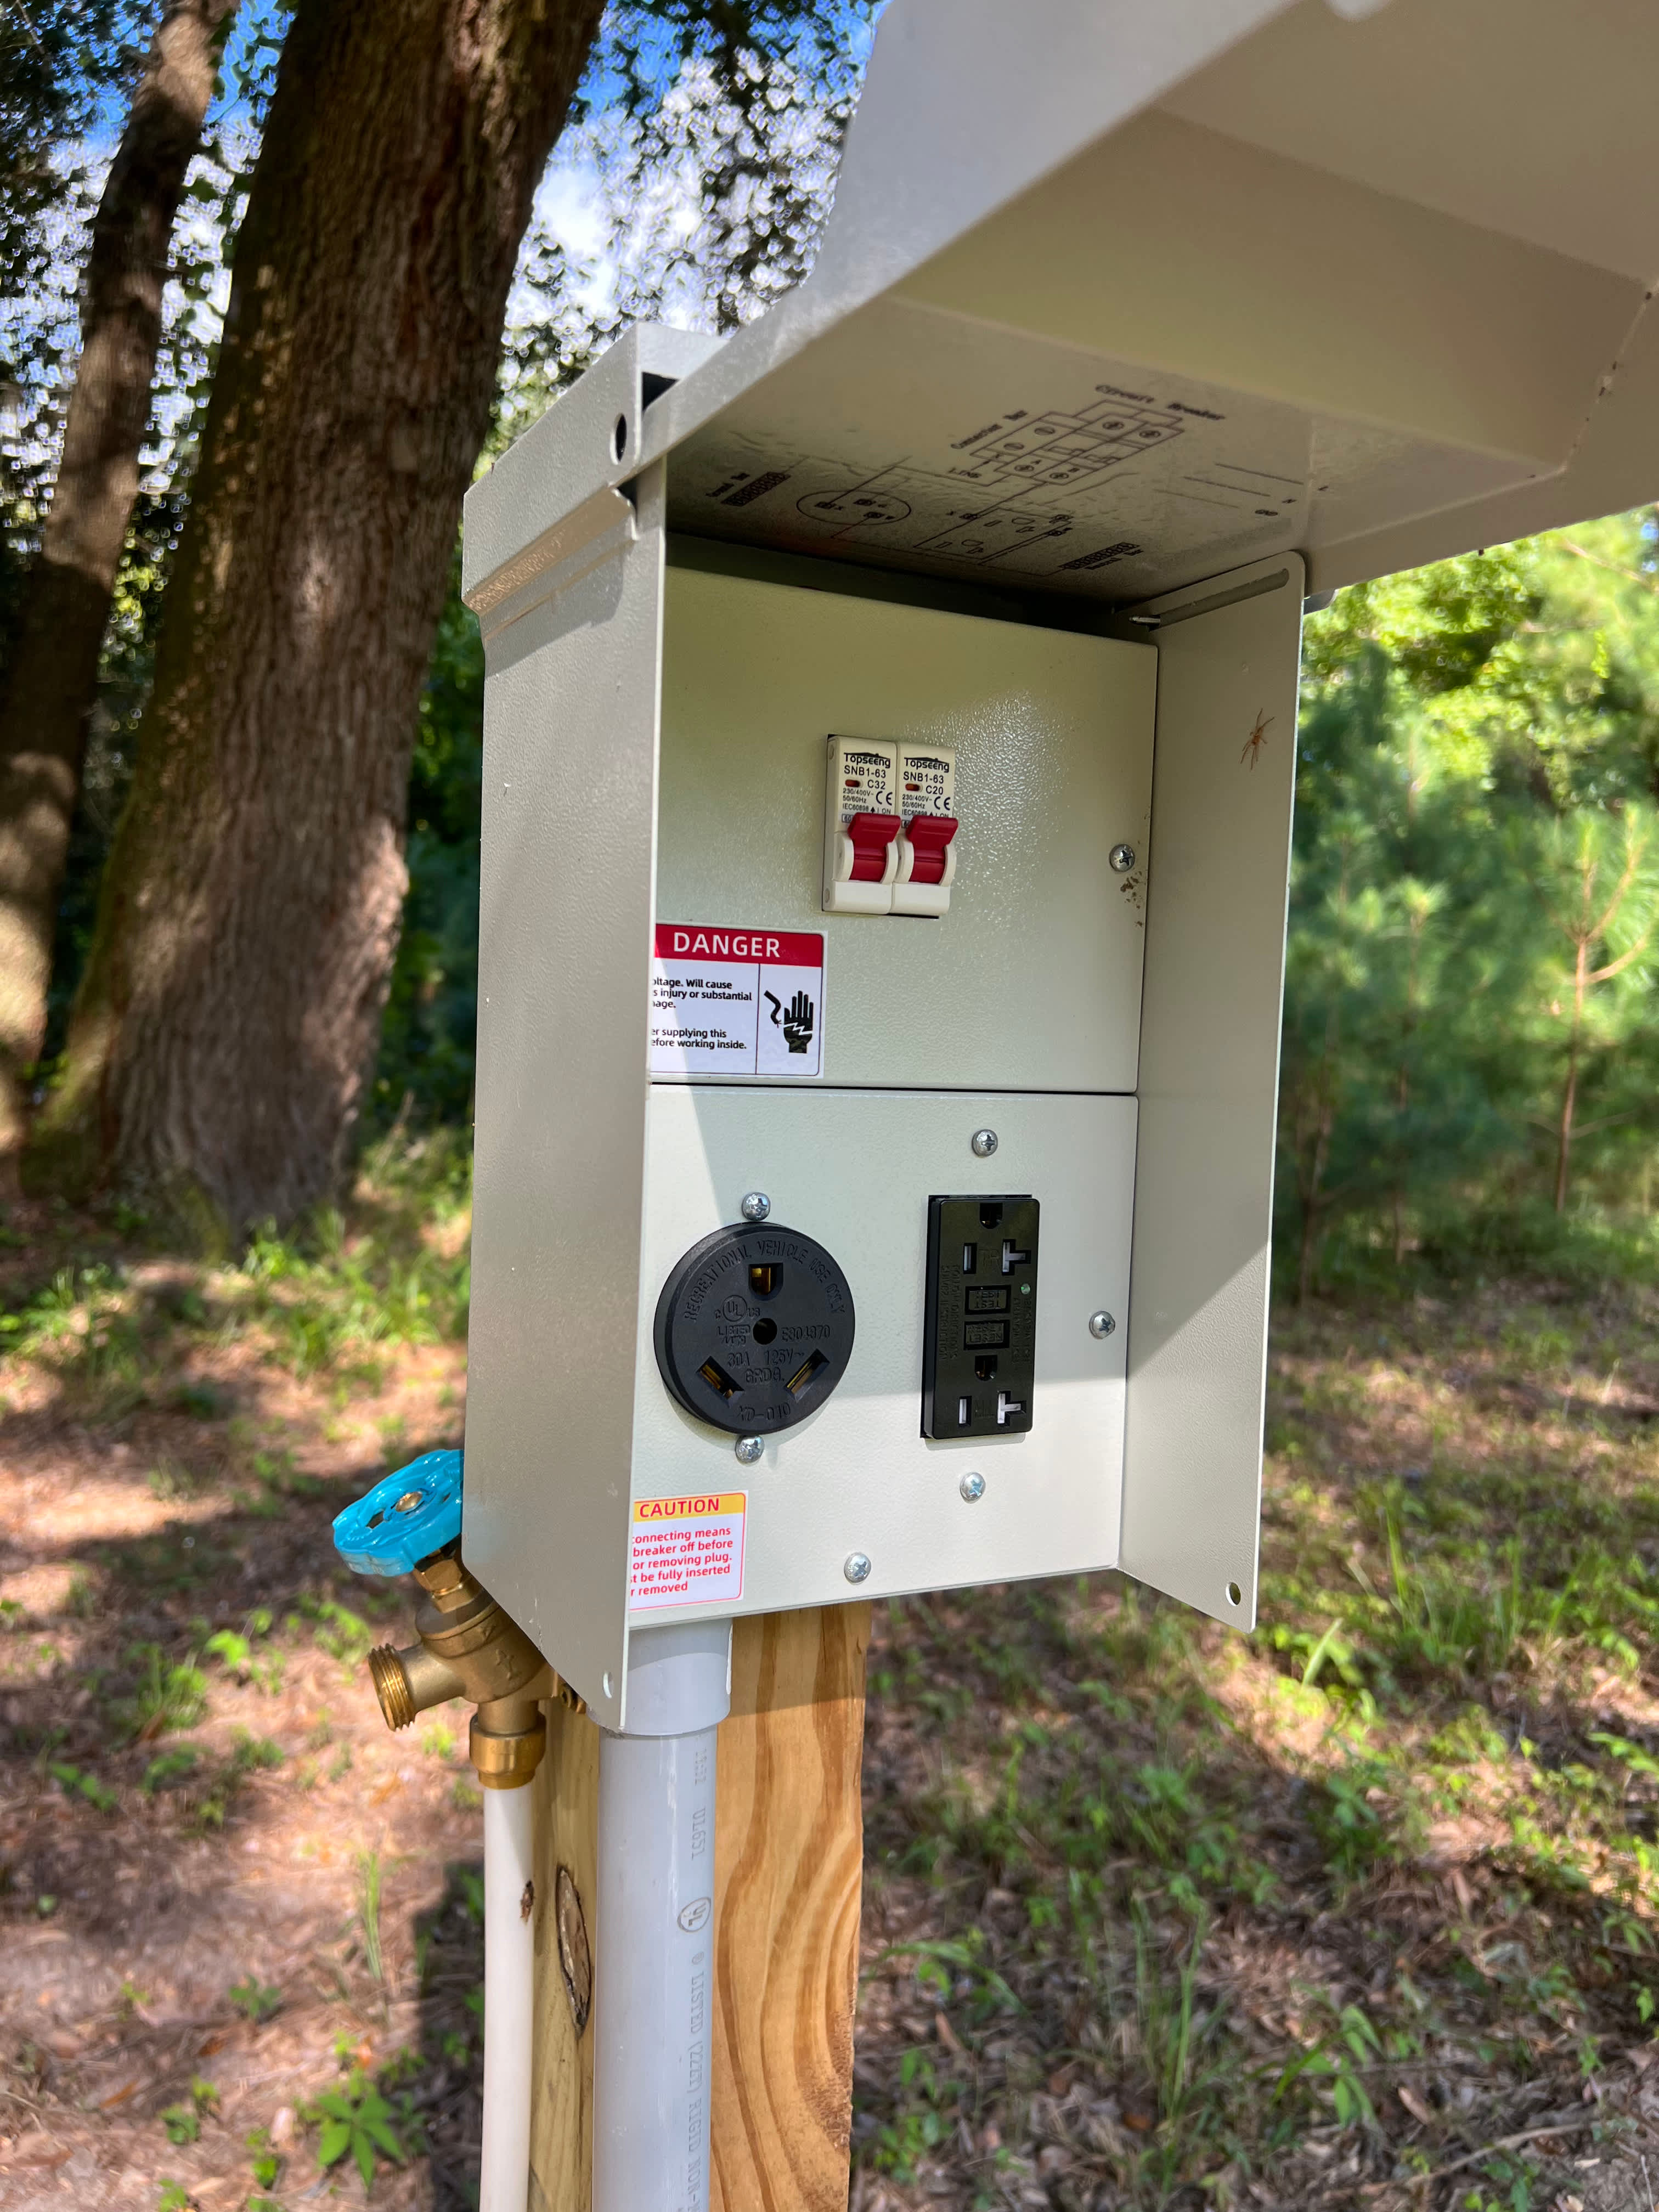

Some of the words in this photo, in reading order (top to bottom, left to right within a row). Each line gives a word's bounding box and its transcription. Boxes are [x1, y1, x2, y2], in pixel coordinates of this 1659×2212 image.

[844, 765, 886, 778] SNB1-63
[903, 771, 944, 784] SNB1-63
[867, 780, 886, 790] C32
[926, 785, 944, 795] C20
[842, 795, 867, 803] 50/60Hz
[842, 803, 869, 812] IEC60898
[674, 932, 780, 957] DANGER
[686, 979, 703, 988] Will
[706, 981, 732, 989] cause
[661, 988, 687, 999] injury
[701, 991, 752, 1001] substantial
[662, 1028, 708, 1039] supplying
[710, 1029, 726, 1037] this
[678, 1039, 715, 1049] working
[717, 1040, 747, 1049] inside.
[757, 1240, 808, 1265] VEHICLE
[810, 1258, 831, 1283] USE
[640, 1498, 719, 1517] CAUTION
[695, 1527, 731, 1538] means
[633, 1544, 676, 1557] breaker
[680, 1542, 695, 1553] off
[698, 1539, 733, 1551] before
[633, 1561, 645, 1570] or
[648, 1555, 701, 1568] removing
[704, 1552, 732, 1565] plug.
[641, 1573, 654, 1582] be
[658, 1569, 683, 1581] fully
[686, 1564, 730, 1578] inserted
[638, 1581, 688, 1595] removed
[690, 1971, 704, 2034] LISTED
[689, 2097, 702, 2152] RIGID
